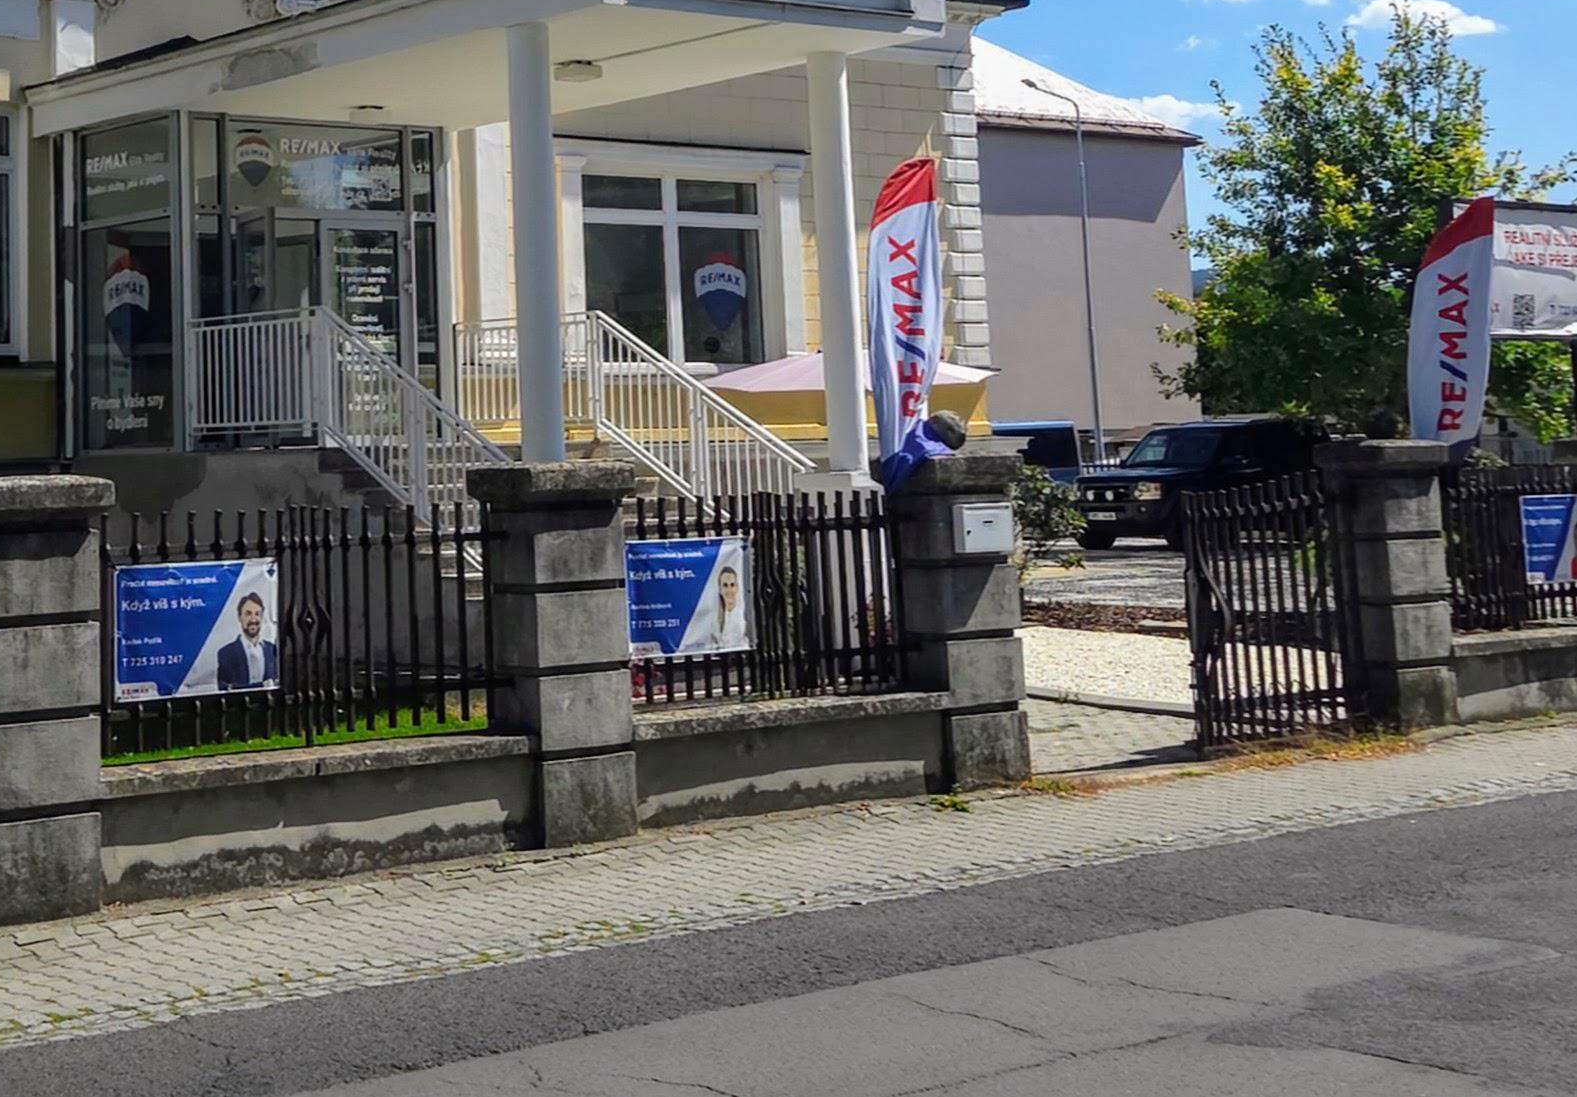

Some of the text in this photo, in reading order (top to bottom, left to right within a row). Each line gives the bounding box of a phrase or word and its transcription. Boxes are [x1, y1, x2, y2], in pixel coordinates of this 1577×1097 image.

[280, 138, 342, 154] RE/MAX
[700, 272, 741, 287] RE/MAX
[108, 281, 145, 300] RE/MAX
[887, 235, 926, 419] RE/MAX
[1437, 272, 1470, 432] RE/MAX
[121, 598, 151, 612] Když
[171, 599, 178, 608] s
